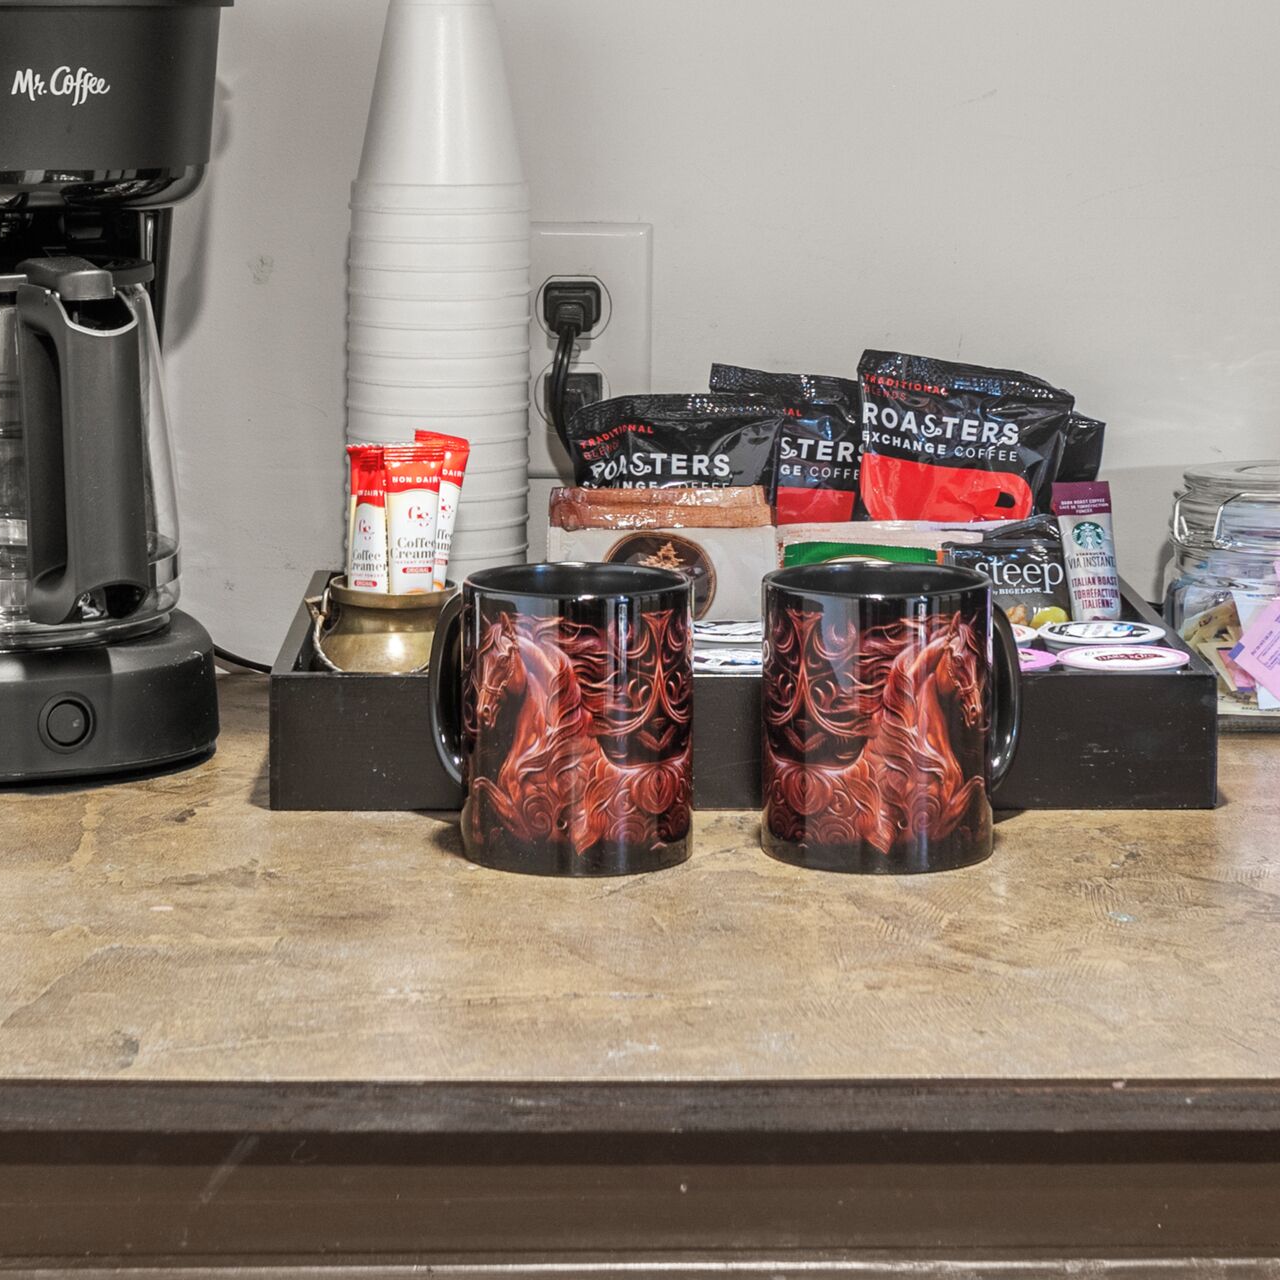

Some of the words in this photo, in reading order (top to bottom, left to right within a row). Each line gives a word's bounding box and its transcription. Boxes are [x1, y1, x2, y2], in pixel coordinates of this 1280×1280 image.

[11, 68, 47, 101] Mr.
[50, 66, 110, 106] Coffee
[864, 373, 949, 397] TRADITIONAL
[580, 423, 655, 450] TRADITIONAL
[862, 402, 1020, 446] ROASTERS
[862, 430, 947, 455] EXCHANGE
[954, 446, 1018, 462] COFFEE
[590, 452, 731, 481] ROASTERS
[975, 557, 1064, 594] steep
[998, 587, 1042, 595] BIGELOW
